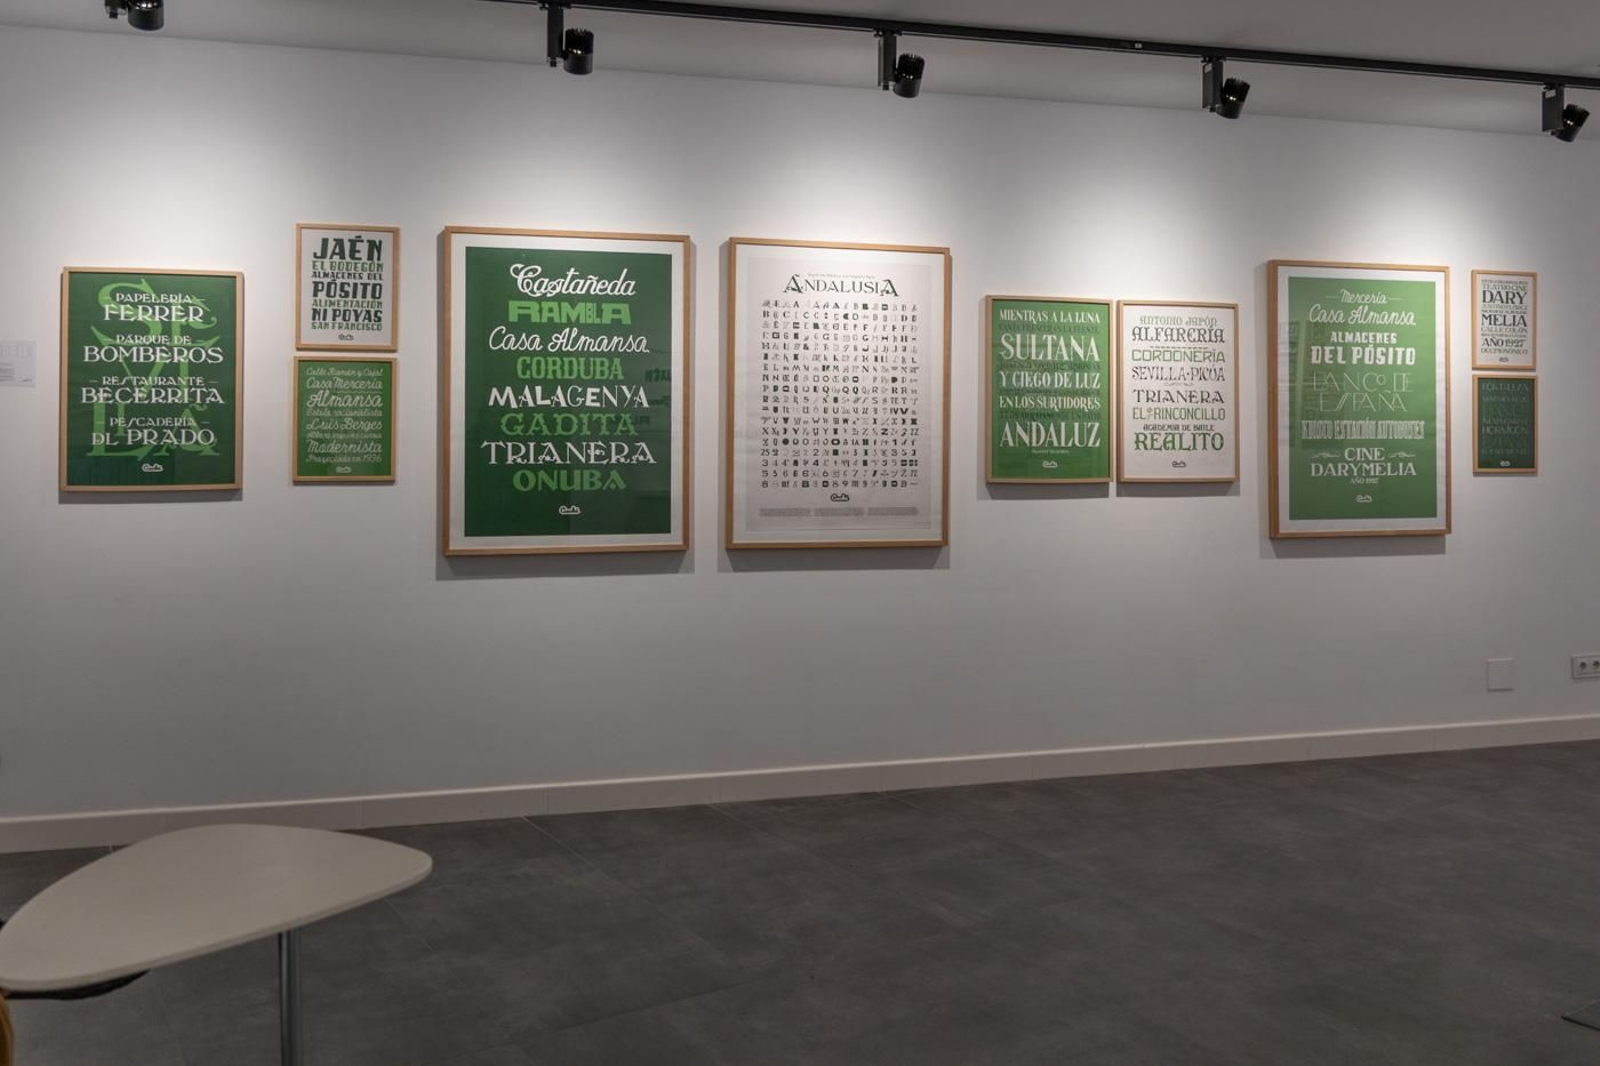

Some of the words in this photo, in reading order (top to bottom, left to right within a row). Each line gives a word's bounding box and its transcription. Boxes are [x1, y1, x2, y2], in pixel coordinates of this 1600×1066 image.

[313, 235, 383, 261] JAÉN
[312, 260, 327, 271] EL
[330, 260, 383, 272] BODEGÓN
[311, 271, 363, 280] ALMACENES
[367, 273, 383, 281] DEL
[510, 264, 636, 297] Castañeda
[312, 279, 382, 299] PÓSITO
[783, 274, 899, 297] ANDALUSIA
[116, 292, 194, 303] PAPELERÍA
[1340, 289, 1388, 304] Mercería
[1482, 290, 1527, 304] DARY
[104, 305, 204, 321] FERRER
[312, 308, 327, 321] NI
[332, 309, 382, 322] POYAS
[508, 300, 631, 324] RAMBLA
[1000, 309, 1049, 323] MIENTRAS
[1049, 311, 1057, 322] A
[1061, 311, 1073, 323] LA
[1076, 311, 1100, 323] LUNA
[1140, 315, 1182, 325] ANTONIO
[1309, 304, 1345, 323] Casa
[1348, 306, 1416, 325] Almansa
[312, 322, 329, 330] SAN
[332, 322, 382, 331] FRANCISCO
[1482, 314, 1527, 327] MELIA
[116, 334, 170, 345] PARQUE
[174, 335, 191, 344] DE
[489, 326, 543, 350] Casa
[548, 327, 649, 352] Almansa
[1132, 325, 1225, 343] ALFARERÍA
[1330, 331, 1397, 344] ALMACENES
[1481, 336, 1504, 347] AÑO
[84, 346, 223, 363] BOMBEROS
[1000, 333, 1099, 361] SULTANA
[1311, 346, 1346, 364] DEL
[1352, 345, 1415, 365] PÓSITO
[1132, 349, 1225, 363] CORDONERÍA
[517, 356, 624, 379] CORDUBA
[102, 376, 205, 386] RESTAURANTE
[307, 377, 331, 389] Casa
[333, 377, 383, 389] Mercería
[1000, 371, 1011, 387] Y
[1012, 371, 1051, 387] CIEGO
[1054, 372, 1071, 388] DE
[1076, 373, 1100, 389] LUZ
[81, 387, 225, 404] BECERRITA
[307, 390, 383, 407] Almansa
[488, 385, 649, 408] MALAGENYA
[1132, 389, 1225, 404] TRIANERA
[1000, 396, 1013, 408] EN
[1015, 396, 1035, 409] LOS
[1037, 396, 1100, 412] SURTIDORES
[110, 417, 196, 426] PESCADERÍA
[1133, 408, 1146, 420] EL
[1153, 408, 1225, 421] RINCONCILLO
[306, 418, 338, 430] Luis
[341, 418, 383, 432] Berges
[500, 412, 638, 435] GADITA
[128, 429, 214, 445] PRADO
[1000, 421, 1100, 448] ANDALUZ
[1134, 432, 1224, 451] REALITO
[307, 439, 382, 453] Modernista
[481, 441, 657, 465] TRIANERA
[1345, 448, 1385, 461] CINE
[1311, 463, 1416, 477] DARYMELIA
[513, 469, 626, 491] ONUBA
